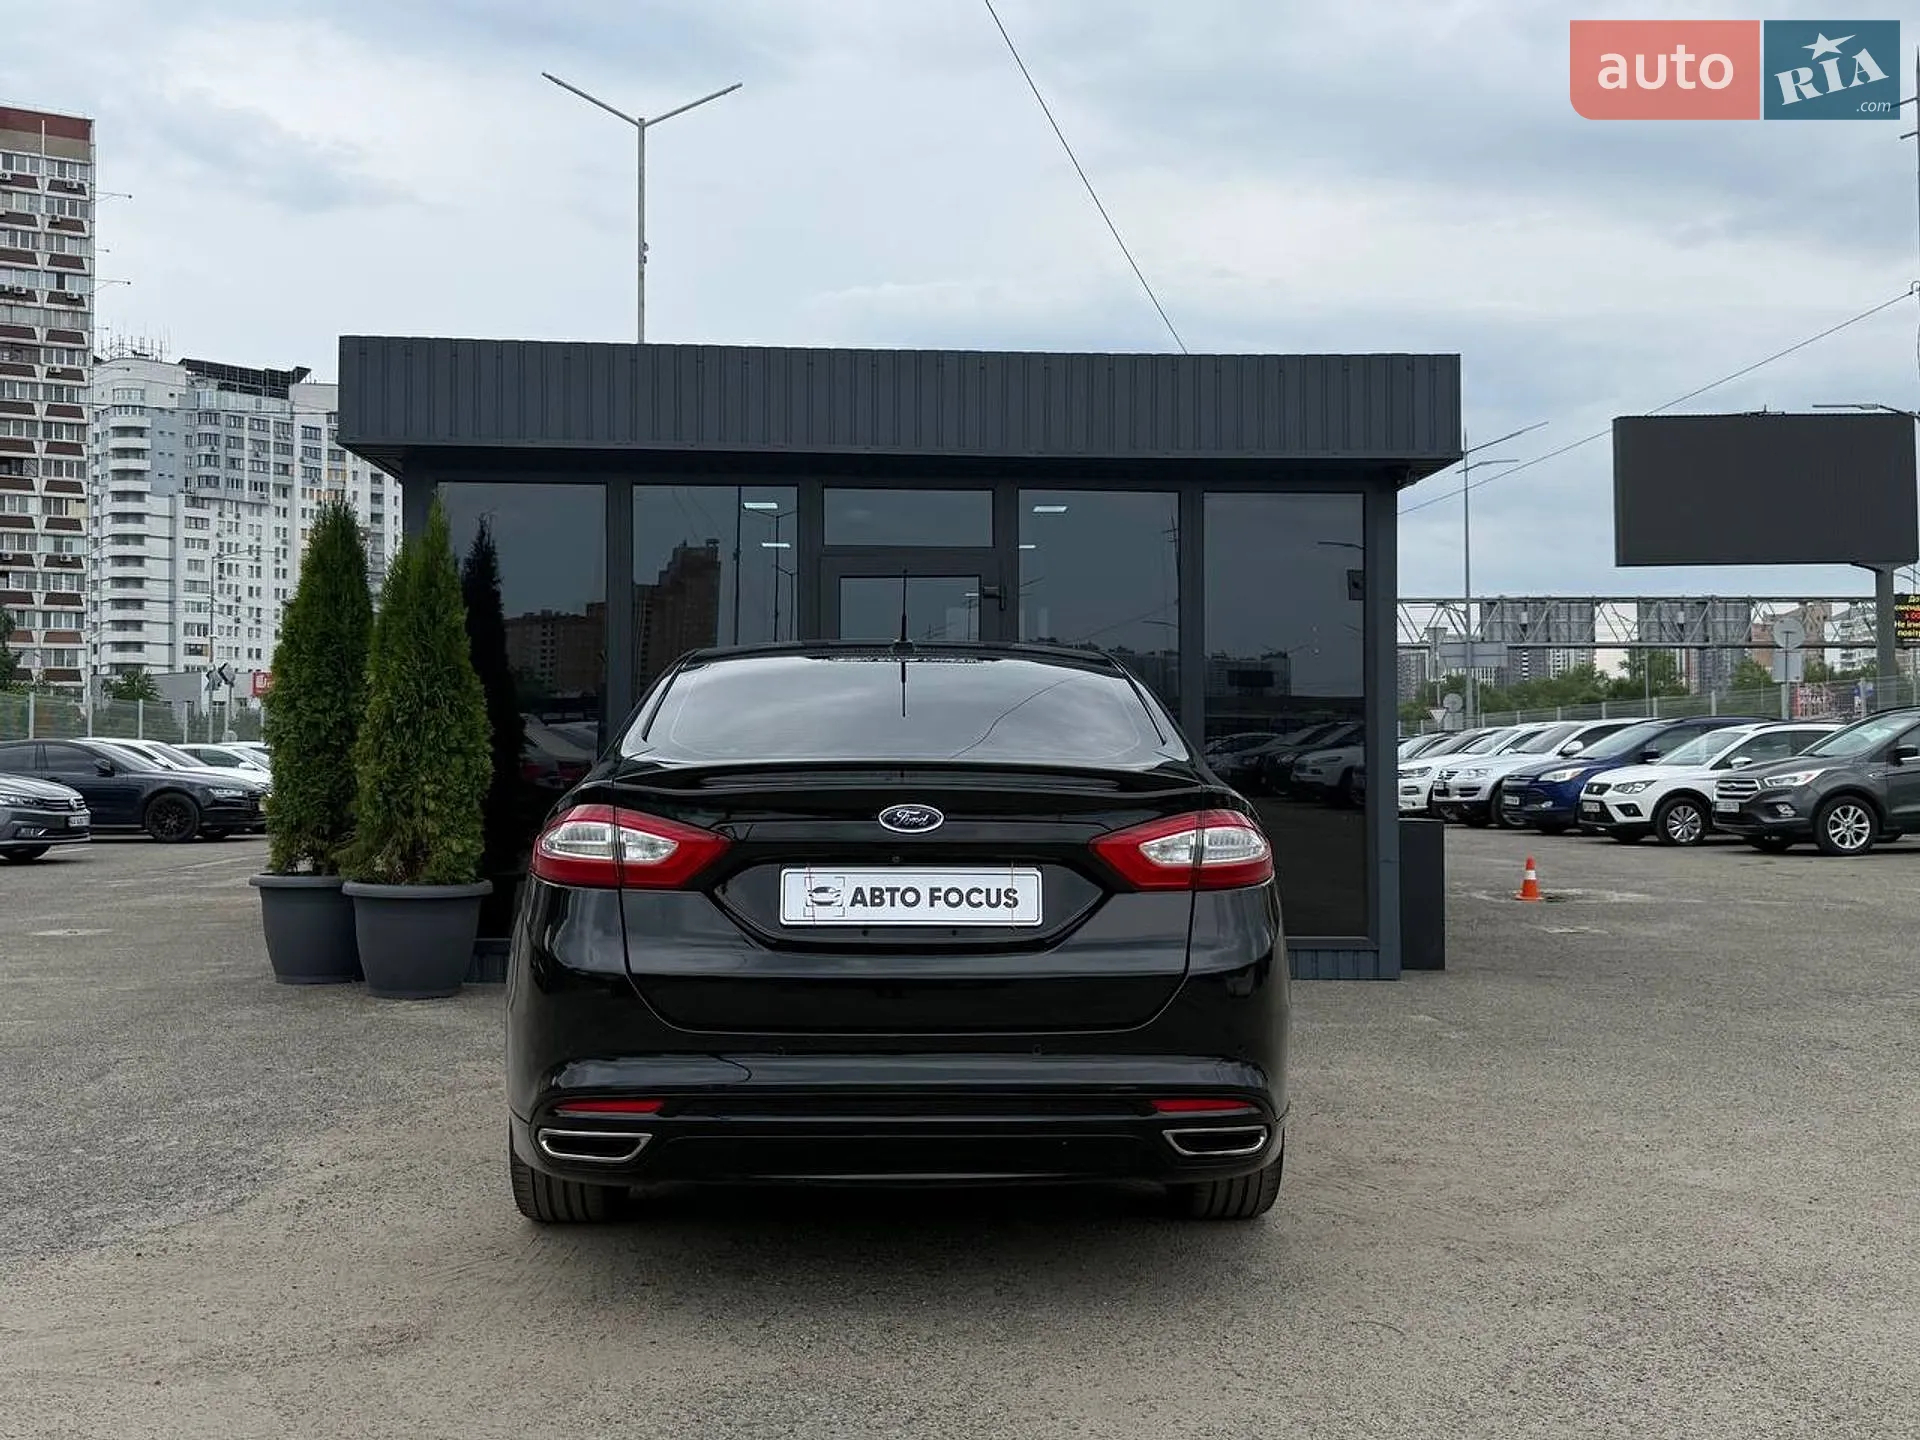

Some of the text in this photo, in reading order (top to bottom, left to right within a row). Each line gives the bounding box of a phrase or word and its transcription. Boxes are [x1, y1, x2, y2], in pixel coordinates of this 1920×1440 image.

[897, 810, 930, 825] Ford
[849, 886, 1019, 909] АВТО FOCUS
